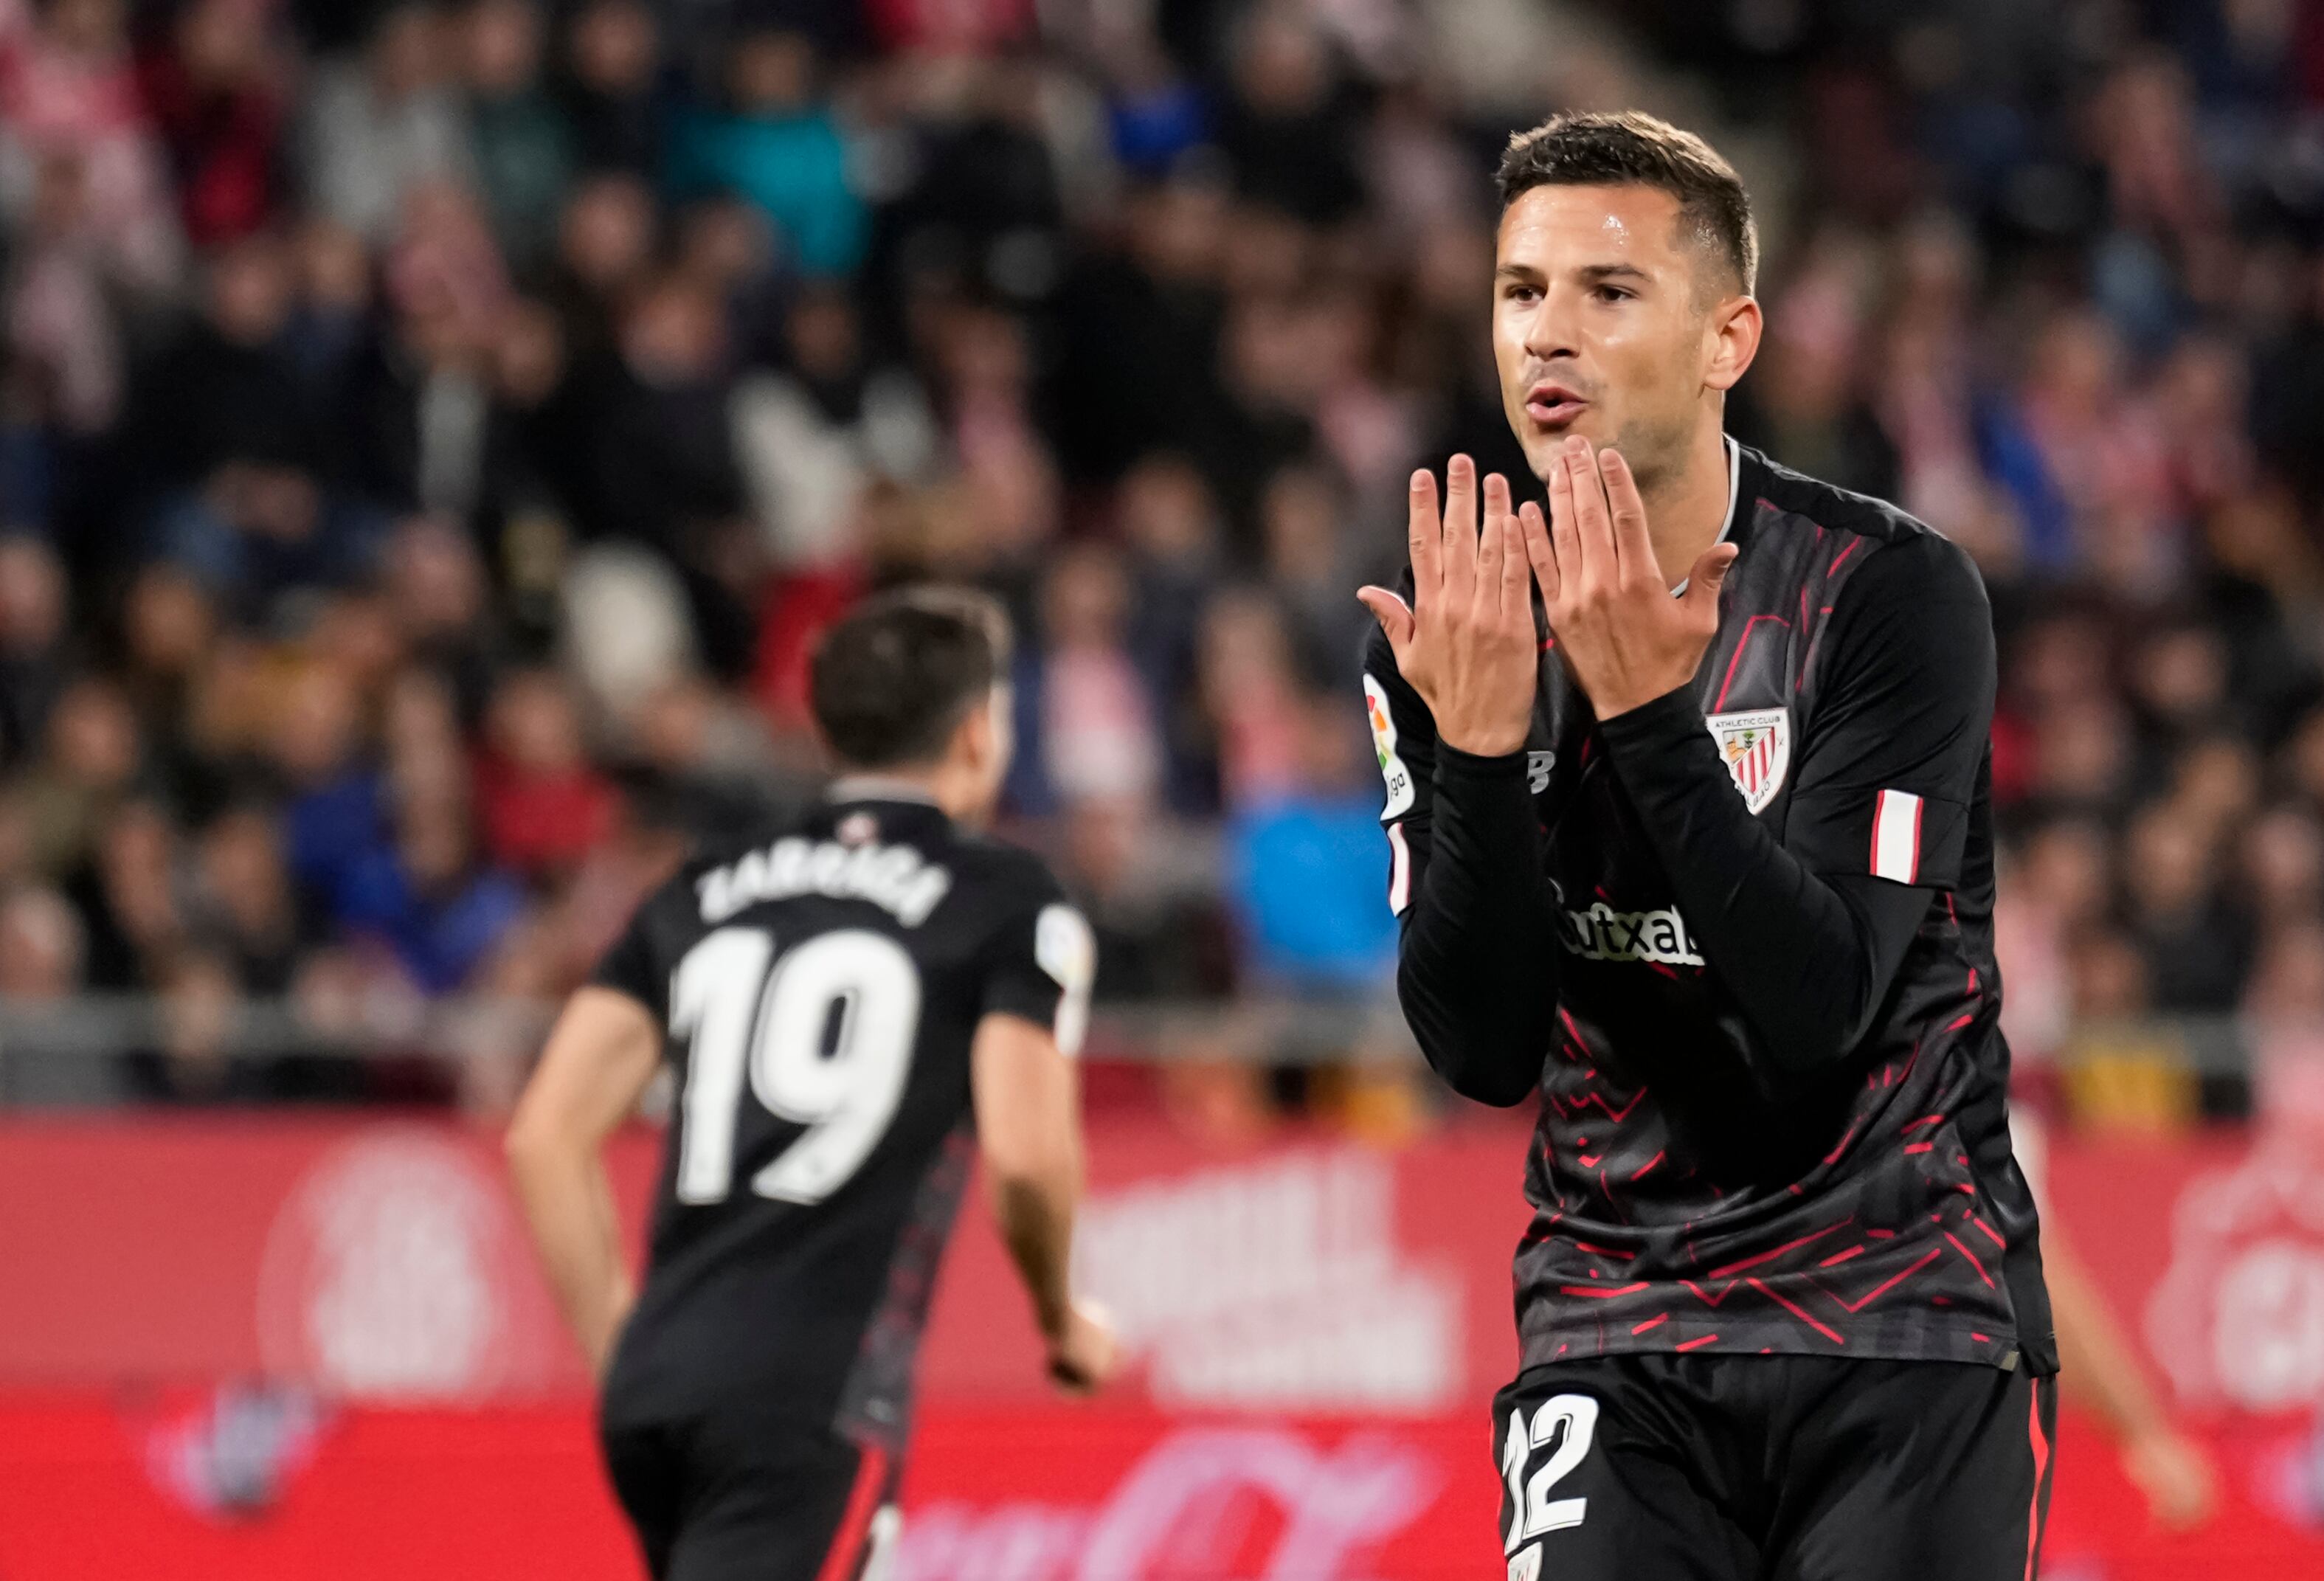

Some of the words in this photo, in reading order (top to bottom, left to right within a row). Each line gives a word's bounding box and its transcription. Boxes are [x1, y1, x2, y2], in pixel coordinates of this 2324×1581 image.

[1527, 750, 1555, 794] B
[1715, 717, 1756, 727] ATHLETIC
[1757, 716, 1780, 724] CLUB
[668, 926, 922, 1206] 19
[1502, 1393, 1600, 1557] 12
